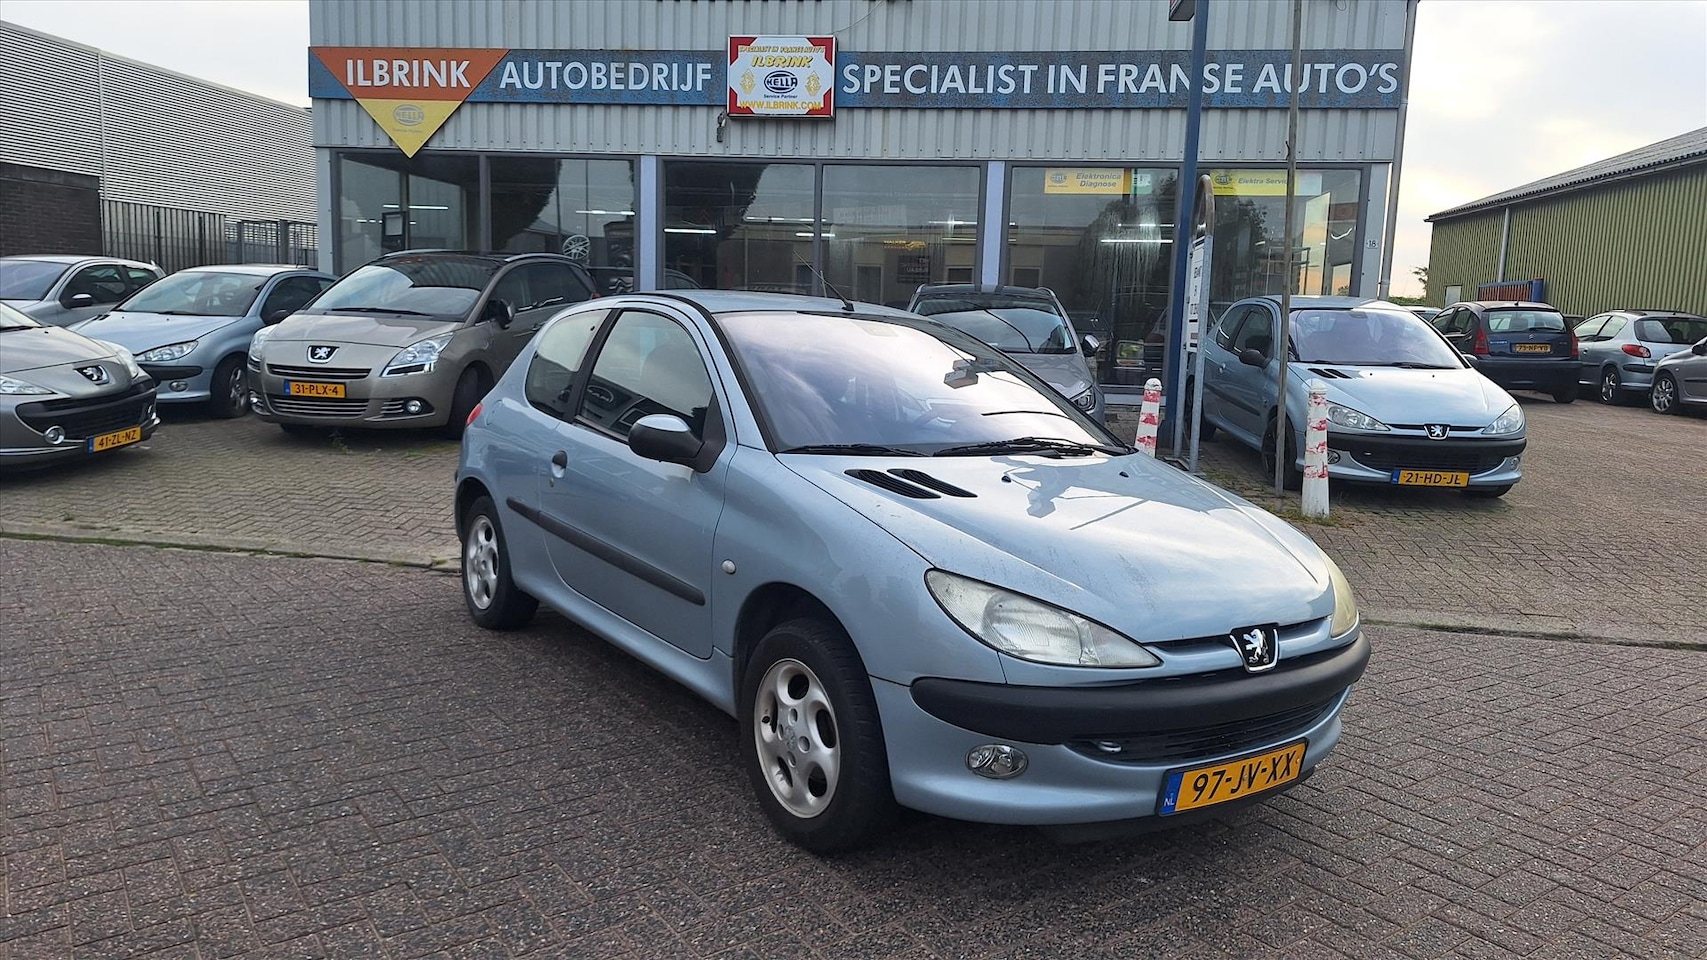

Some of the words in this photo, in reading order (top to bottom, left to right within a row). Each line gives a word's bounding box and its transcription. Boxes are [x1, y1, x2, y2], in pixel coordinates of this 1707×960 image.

[751, 56, 814, 68] ILBRINK
[346, 59, 471, 88] ILBRINK
[500, 61, 712, 91] AUTOBEDRIJF
[842, 64, 1038, 94] SPECIALIST
[1047, 65, 1087, 93] IN
[1252, 63, 1398, 94] AUTO'S
[740, 101, 822, 110] WWW.ILBRINK.COM
[1076, 172, 1121, 180] Elektronica
[1238, 177, 1264, 185] Elektra
[1080, 180, 1117, 188] Diagnose
[1368, 240, 1377, 248] 18
[295, 383, 338, 396] 31-PLX-4
[99, 429, 137, 448] 41-ZL-NZ
[1193, 750, 1297, 803] 97-JV-XX
[1164, 797, 1175, 806] NL
